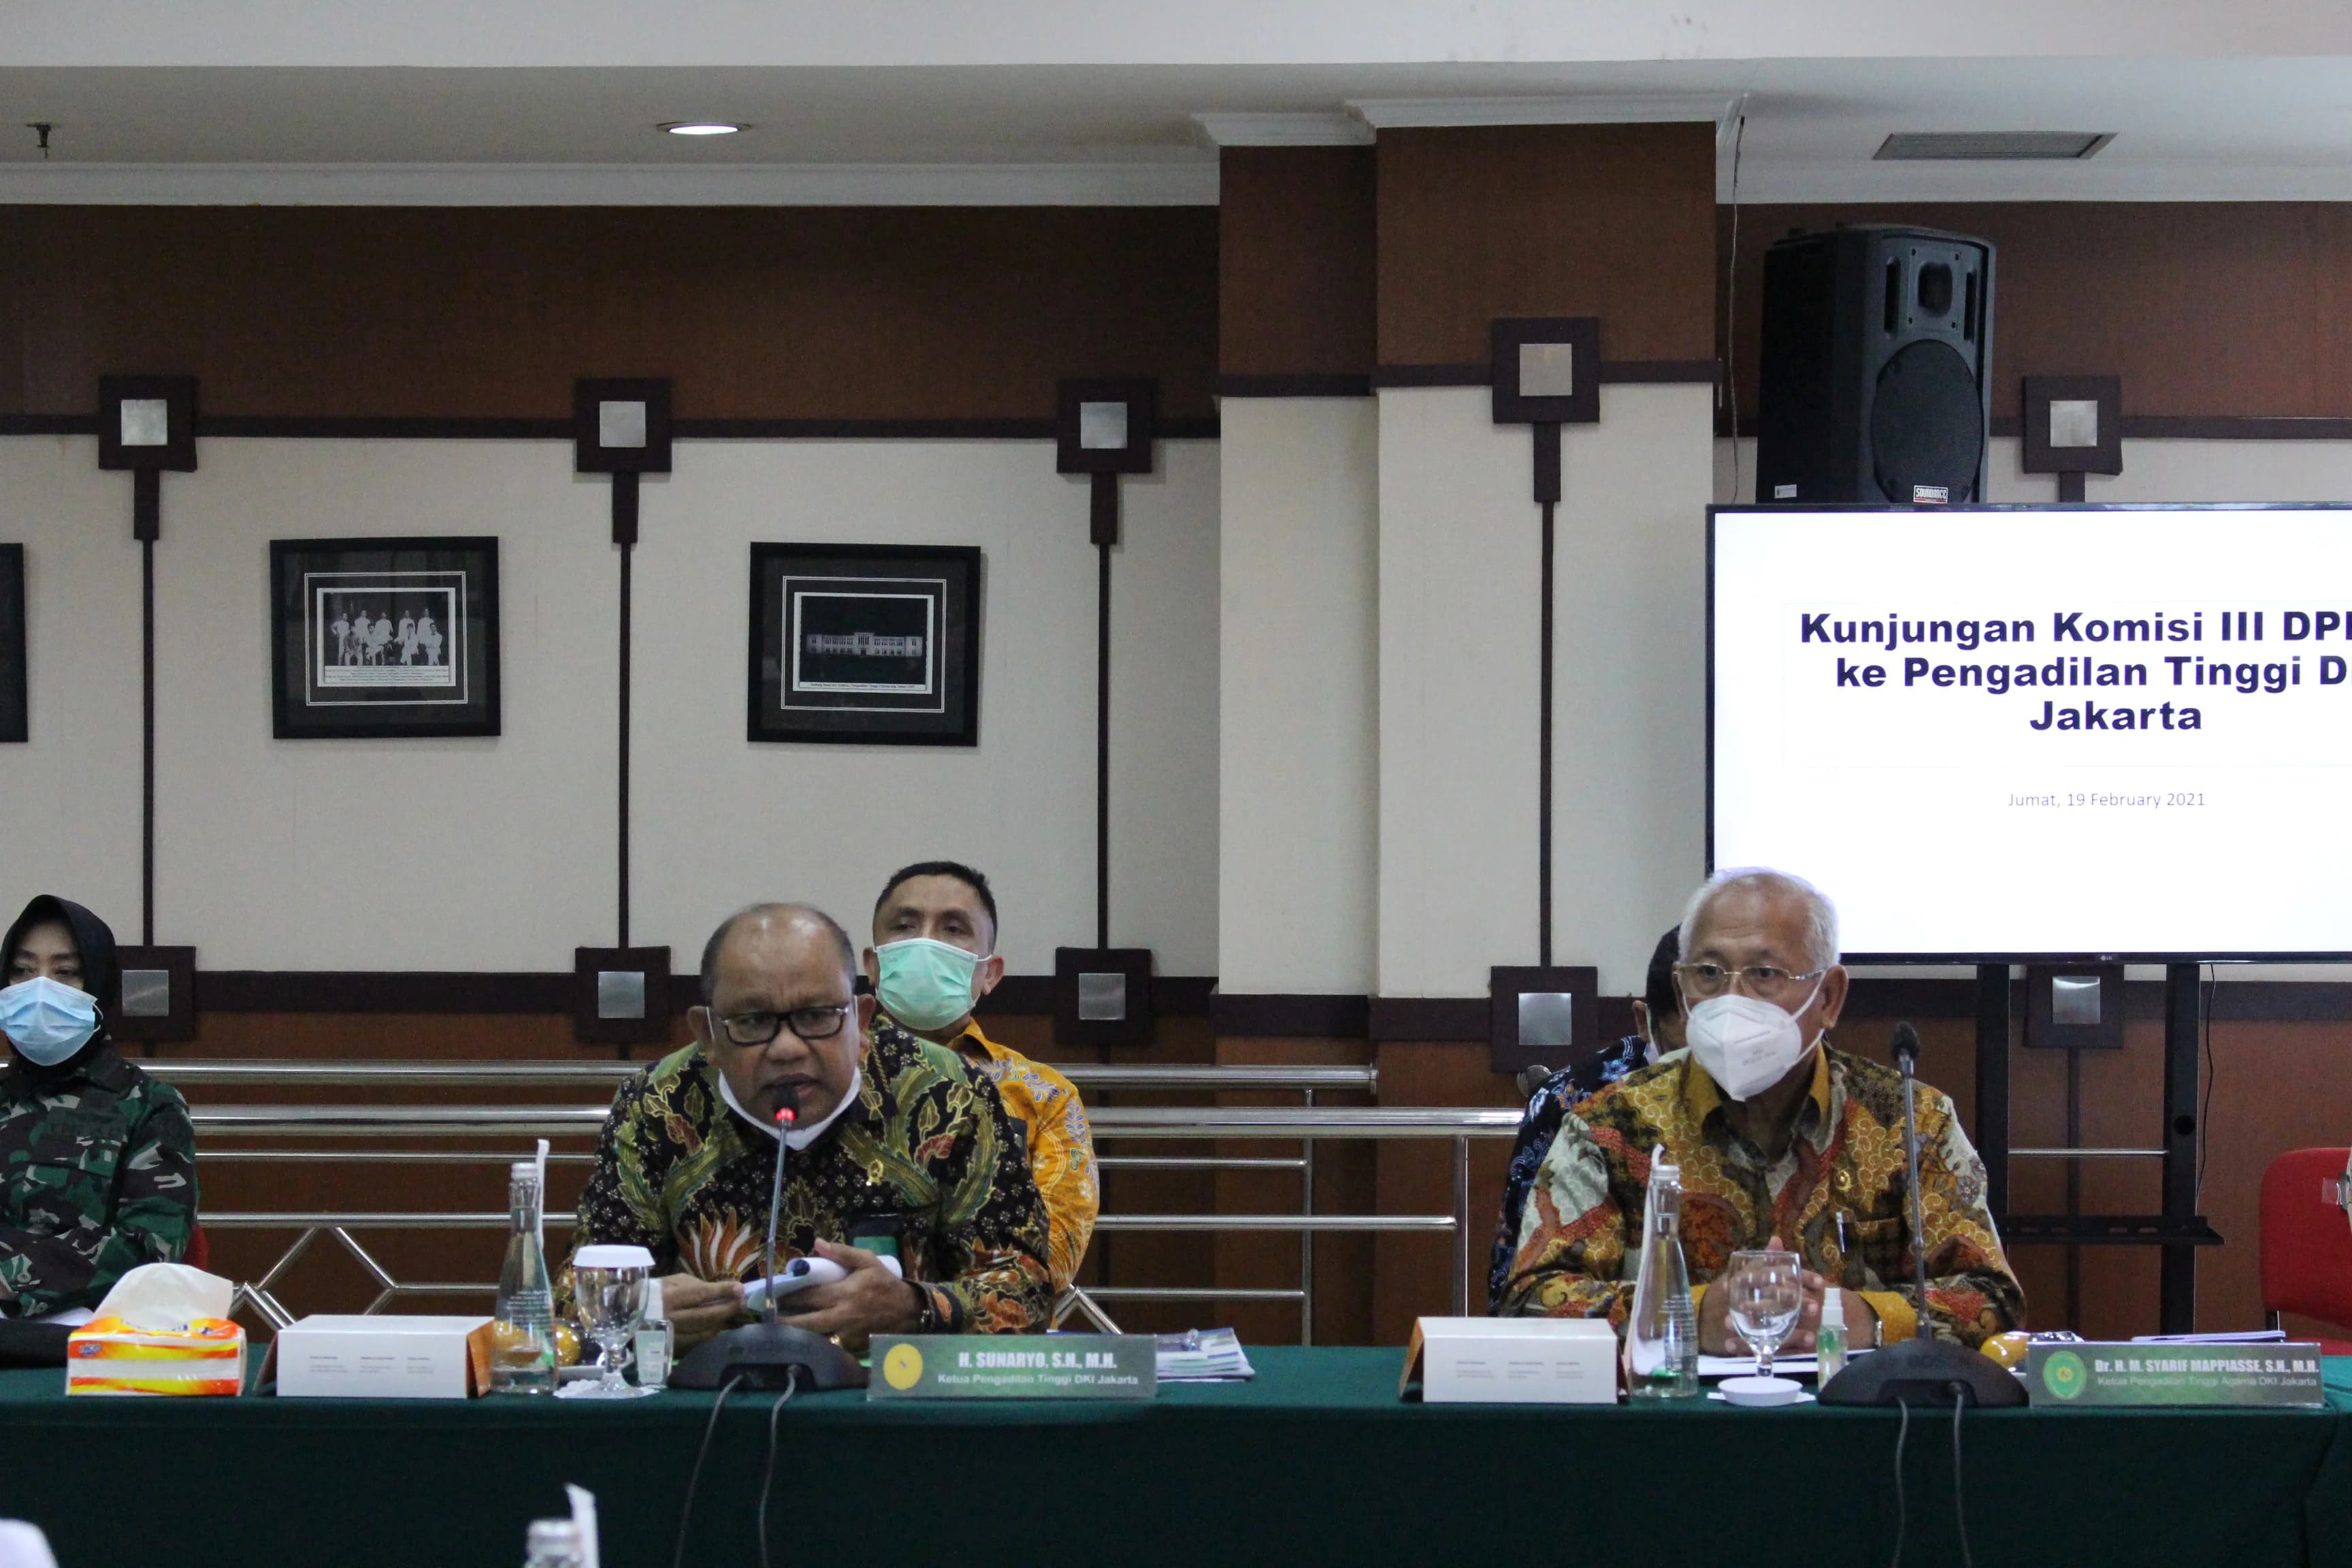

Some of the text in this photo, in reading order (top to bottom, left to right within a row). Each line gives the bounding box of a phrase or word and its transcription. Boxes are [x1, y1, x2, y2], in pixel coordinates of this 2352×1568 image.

[1802, 611, 2352, 651] Kunjungan Komisi III DP
[1837, 655, 2352, 694] ke Pengadilan Tinggi D
[2029, 700, 2202, 731] Jakarta
[2008, 792, 2205, 809] Jumat, 19 February 2021
[958, 1352, 973, 1368] H.
[1085, 1352, 1117, 1369] M.H.
[2095, 1359, 2112, 1373] Dr.
[2114, 1359, 2127, 1373] H.
[2129, 1359, 2144, 1373] M.
[2146, 1359, 2189, 1373] SYARIF
[2292, 1359, 2320, 1373] M.H.
[938, 1374, 1139, 1386] Ketua Pengadilan Tinggi DKI Jakarta
[2259, 1377, 2278, 1386] DKI
[2281, 1377, 2317, 1386] Jakarta
